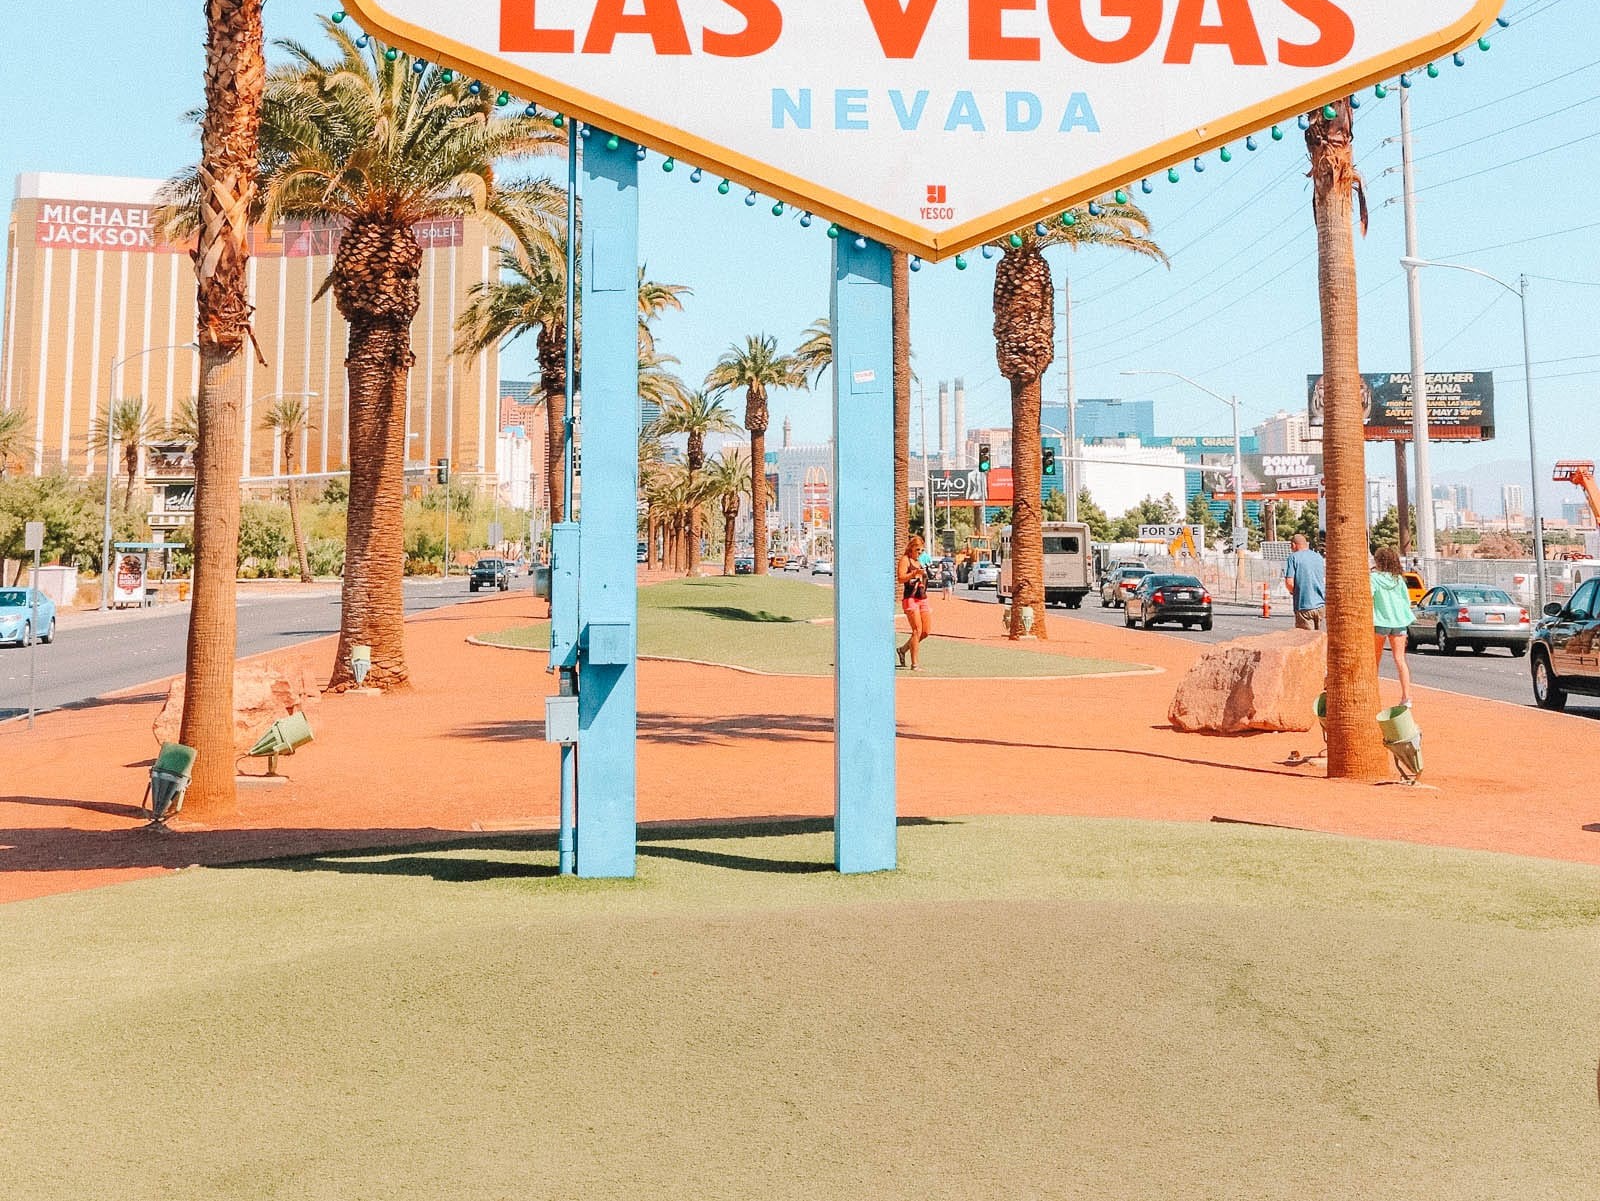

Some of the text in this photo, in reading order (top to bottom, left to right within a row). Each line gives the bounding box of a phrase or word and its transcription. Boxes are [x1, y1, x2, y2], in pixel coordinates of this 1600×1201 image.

[771, 88, 1101, 133] NEVADA
[44, 204, 154, 228] MICHAEL
[920, 207, 954, 220] YESCO
[42, 224, 155, 246] JACKSON
[1389, 373, 1474, 384] MAEATHER
[1432, 408, 1453, 416] MAY
[1263, 455, 1310, 467] DONNY
[1142, 526, 1199, 536] FOR SAE
